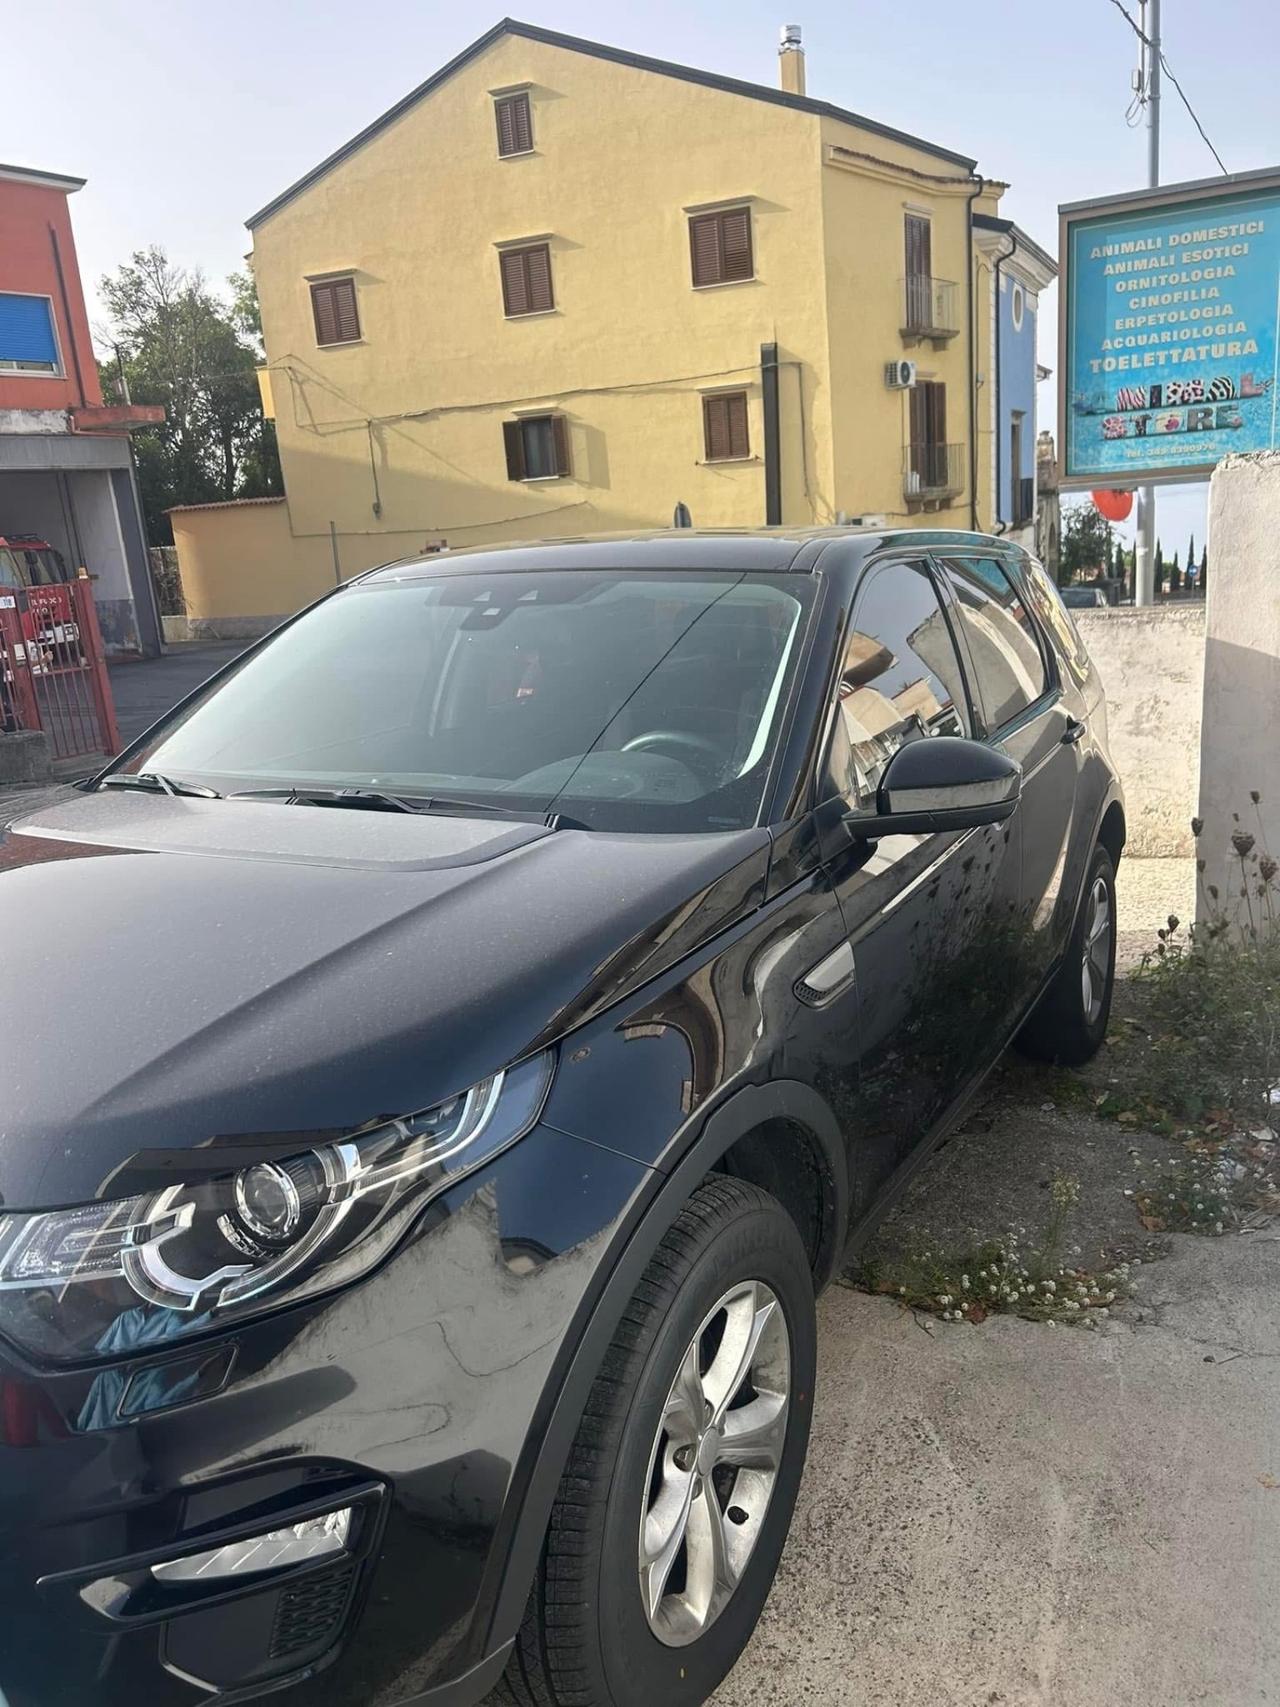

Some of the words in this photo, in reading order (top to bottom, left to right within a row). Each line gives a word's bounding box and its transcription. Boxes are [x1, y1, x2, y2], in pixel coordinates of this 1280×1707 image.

[1090, 237, 1162, 259] ANIMALI
[1168, 220, 1265, 247] DOMESTICI
[1104, 255, 1175, 276] ANIMALI
[1182, 243, 1249, 264] ESOTICI
[1115, 265, 1236, 293] ORNITOLOGIA
[1129, 287, 1220, 310] CINOFILIA
[1114, 304, 1234, 331] ERPETOLOGIA
[1101, 321, 1247, 351] ACQUARIOLOGIA
[1090, 338, 1258, 374] TOELETTATURA
[1102, 402, 1243, 440] STORE
